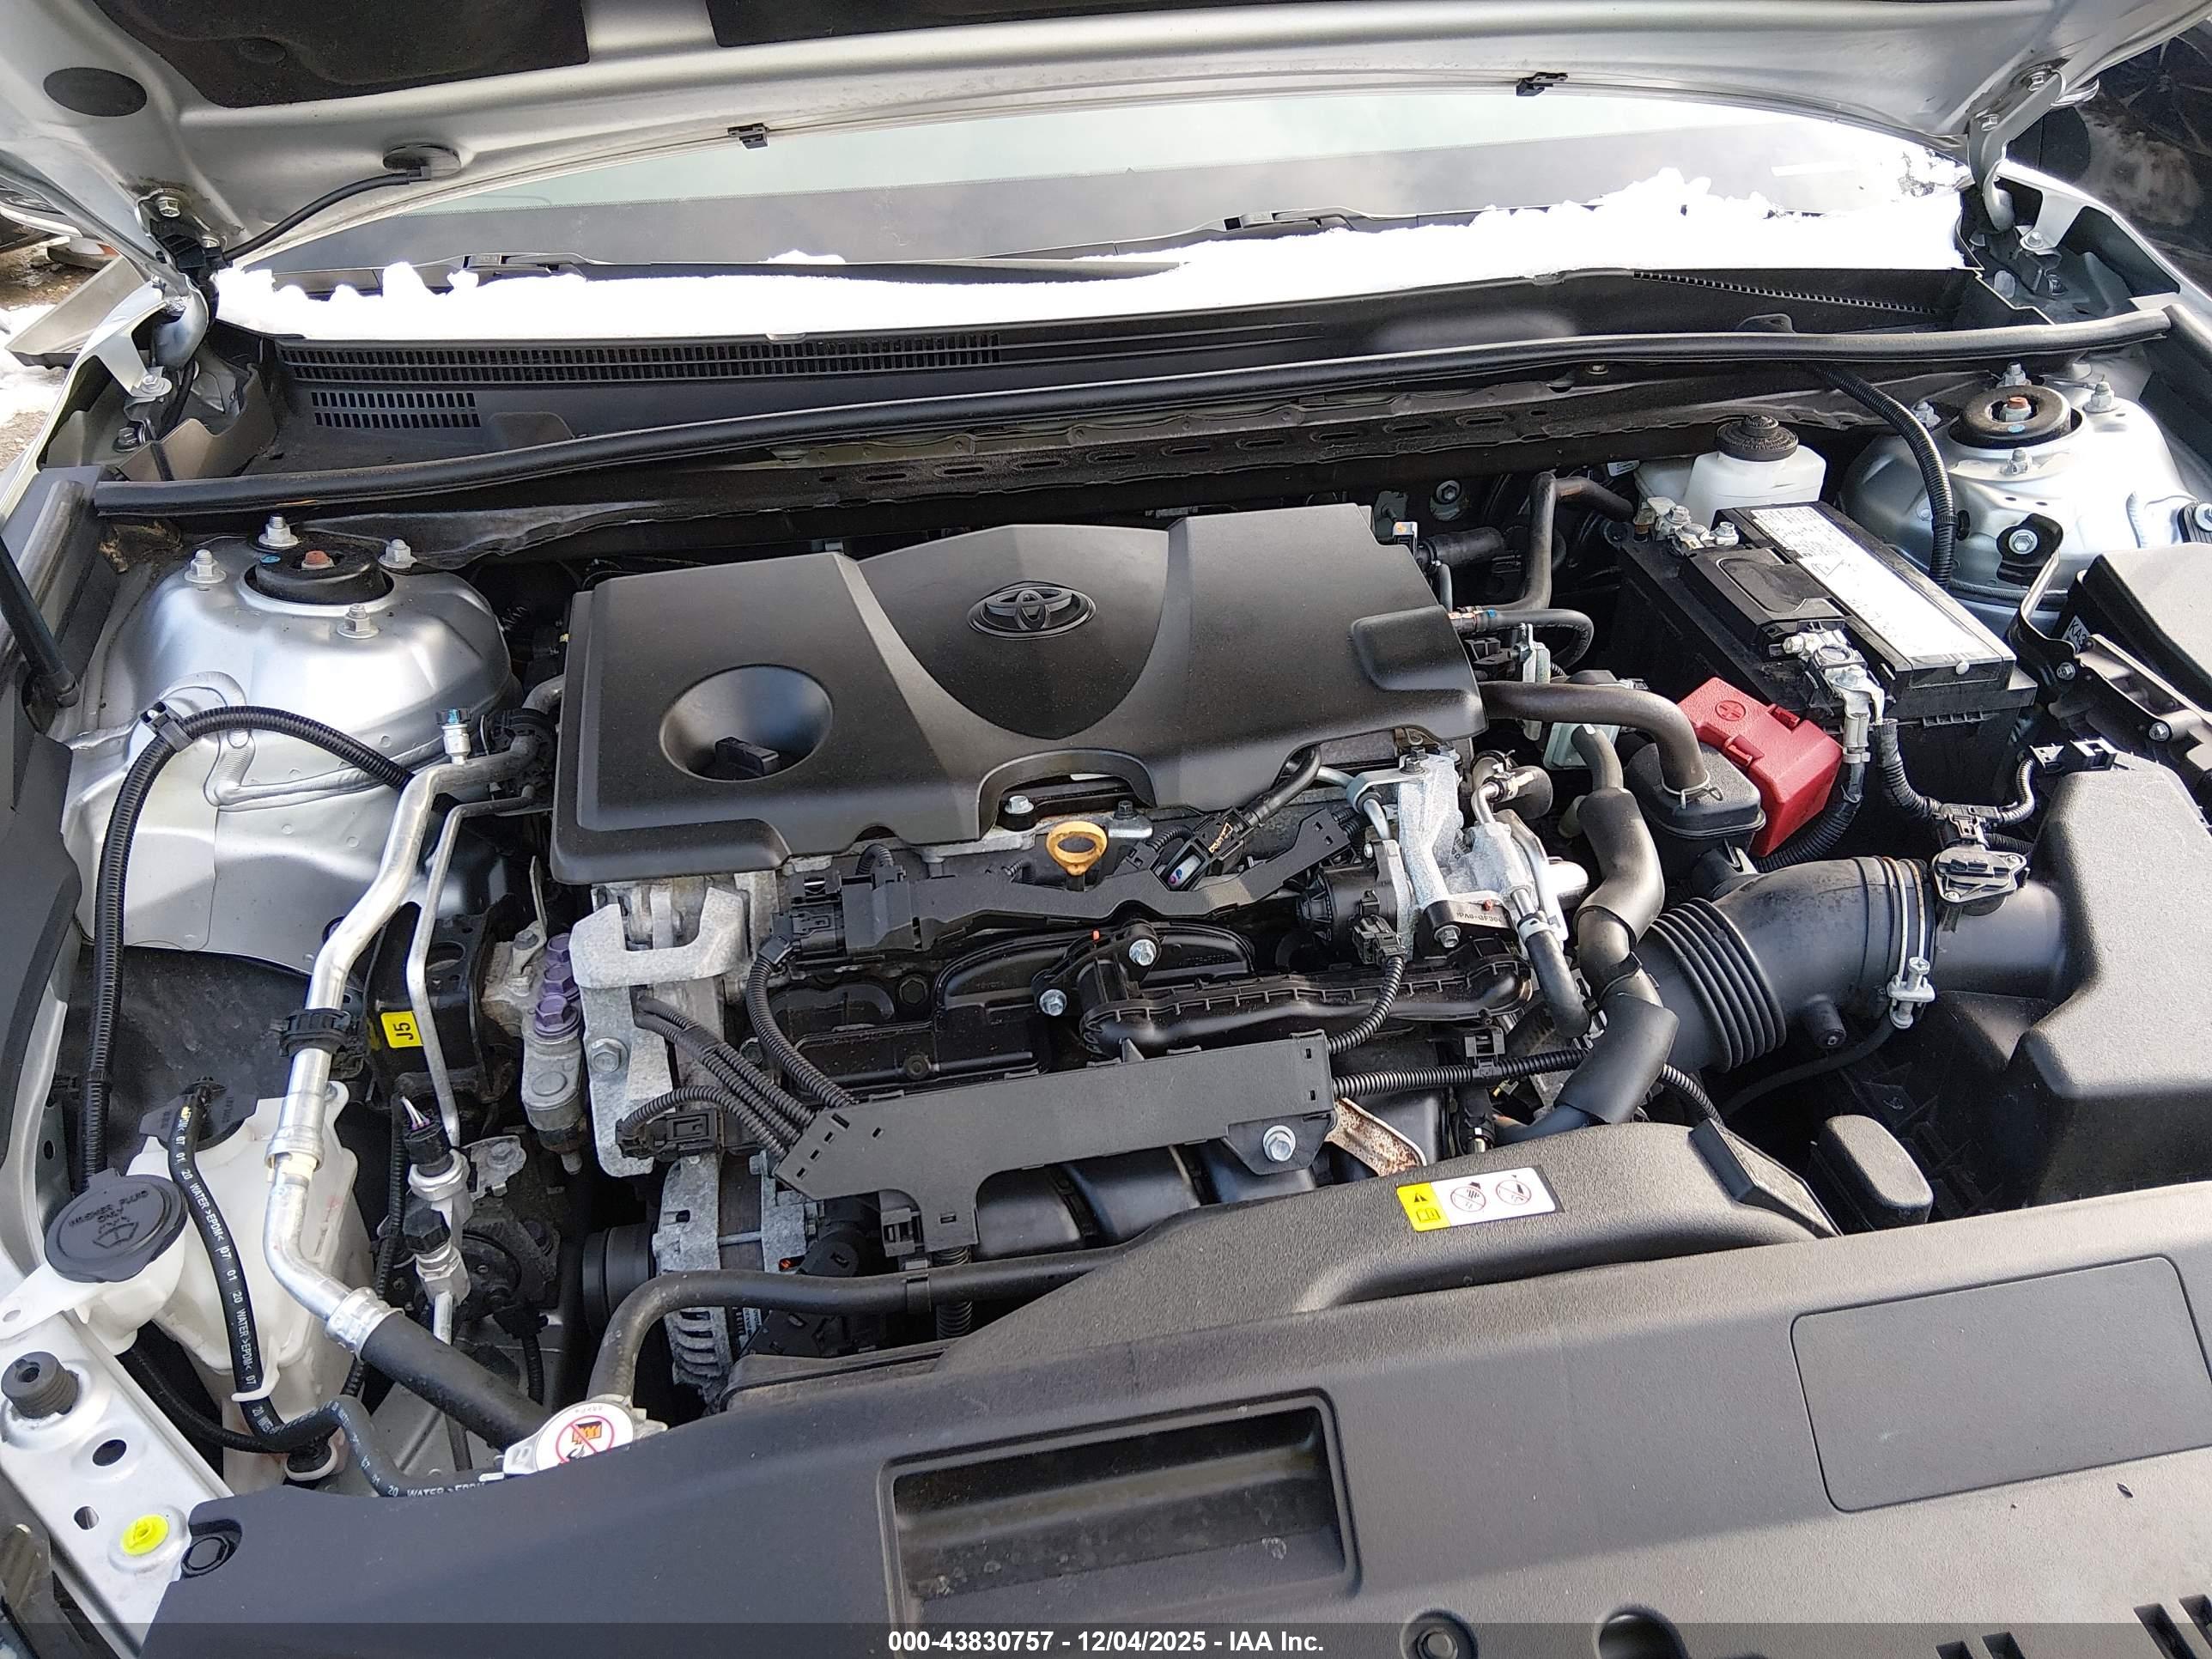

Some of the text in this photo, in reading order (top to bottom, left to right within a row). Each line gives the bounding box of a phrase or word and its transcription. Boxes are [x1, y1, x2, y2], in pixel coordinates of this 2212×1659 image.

[392, 1022, 414, 1041] J5
[176, 1135, 186, 1146] 07
[176, 1152, 186, 1164] 01
[181, 1169, 193, 1180] 20
[189, 1182, 210, 1210] WATER
[205, 1209, 225, 1242] >EPDM<
[227, 1269, 238, 1281] 01
[233, 1291, 243, 1304] 20
[236, 1308, 249, 1338] WATER
[246, 1375, 257, 1385] 07
[387, 1485, 399, 1498] 20
